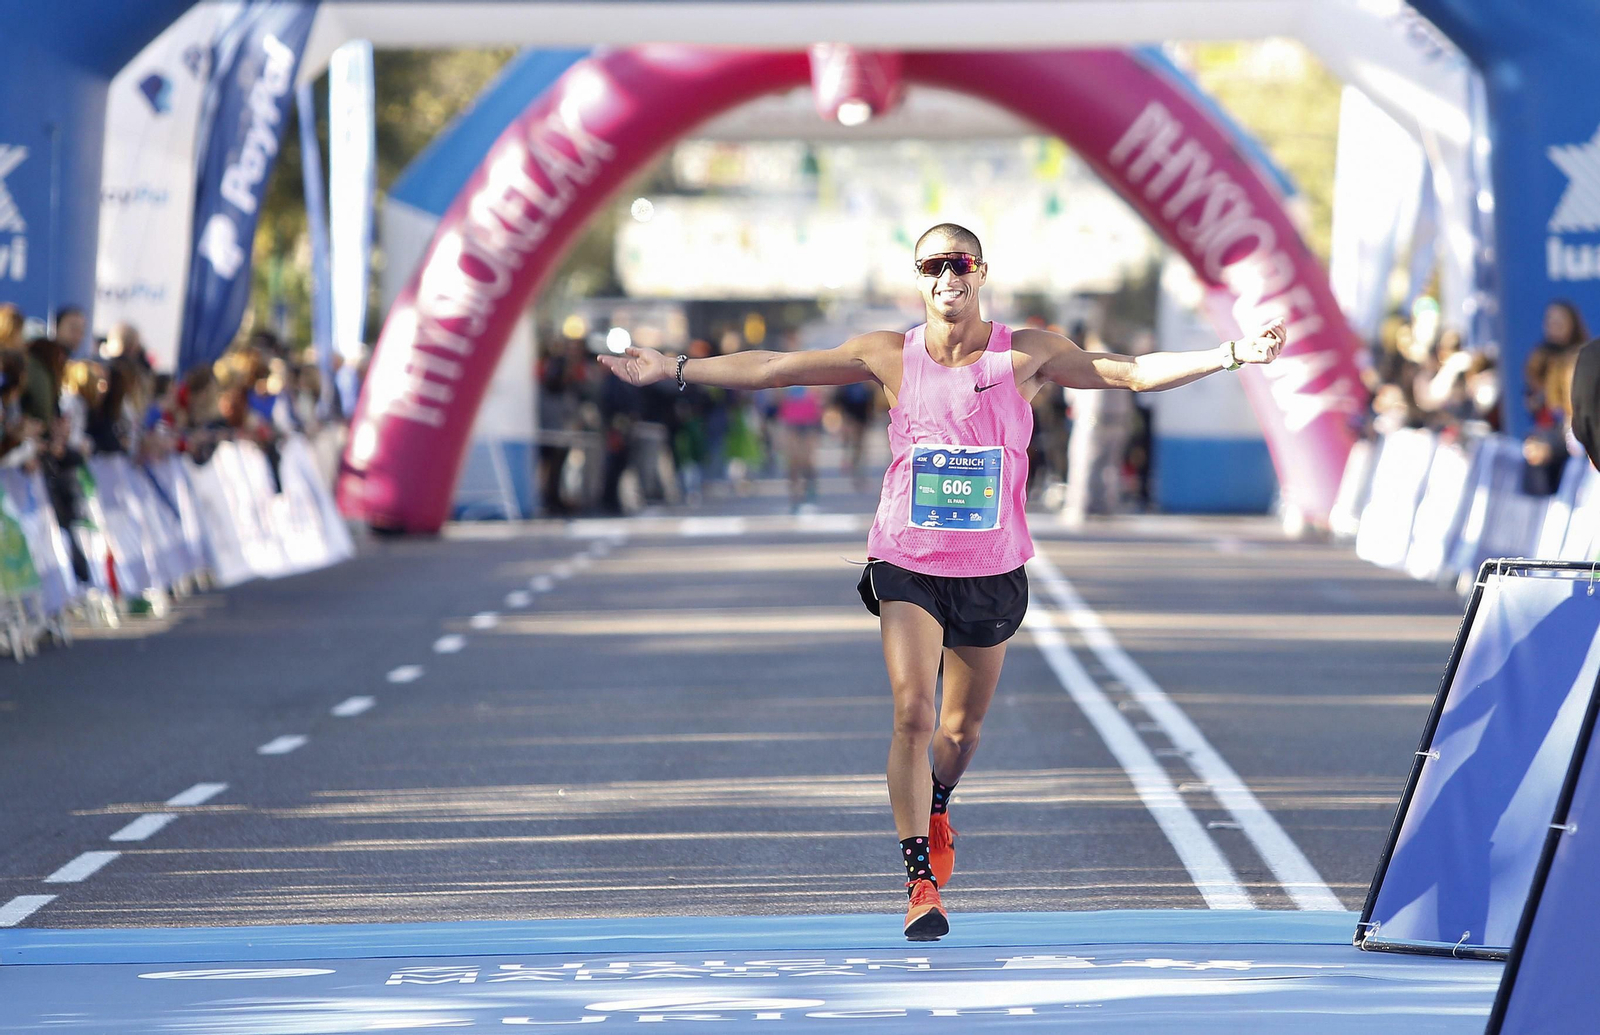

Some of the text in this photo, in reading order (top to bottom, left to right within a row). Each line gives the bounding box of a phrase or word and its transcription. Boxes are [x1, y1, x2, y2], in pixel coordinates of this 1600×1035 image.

[219, 33, 296, 215] PayPal
[372, 103, 617, 428] PHYSIORELAX
[1108, 101, 1357, 432] PHYSIORELAX
[942, 479, 972, 496] 606
[949, 457, 985, 466] ZURICH
